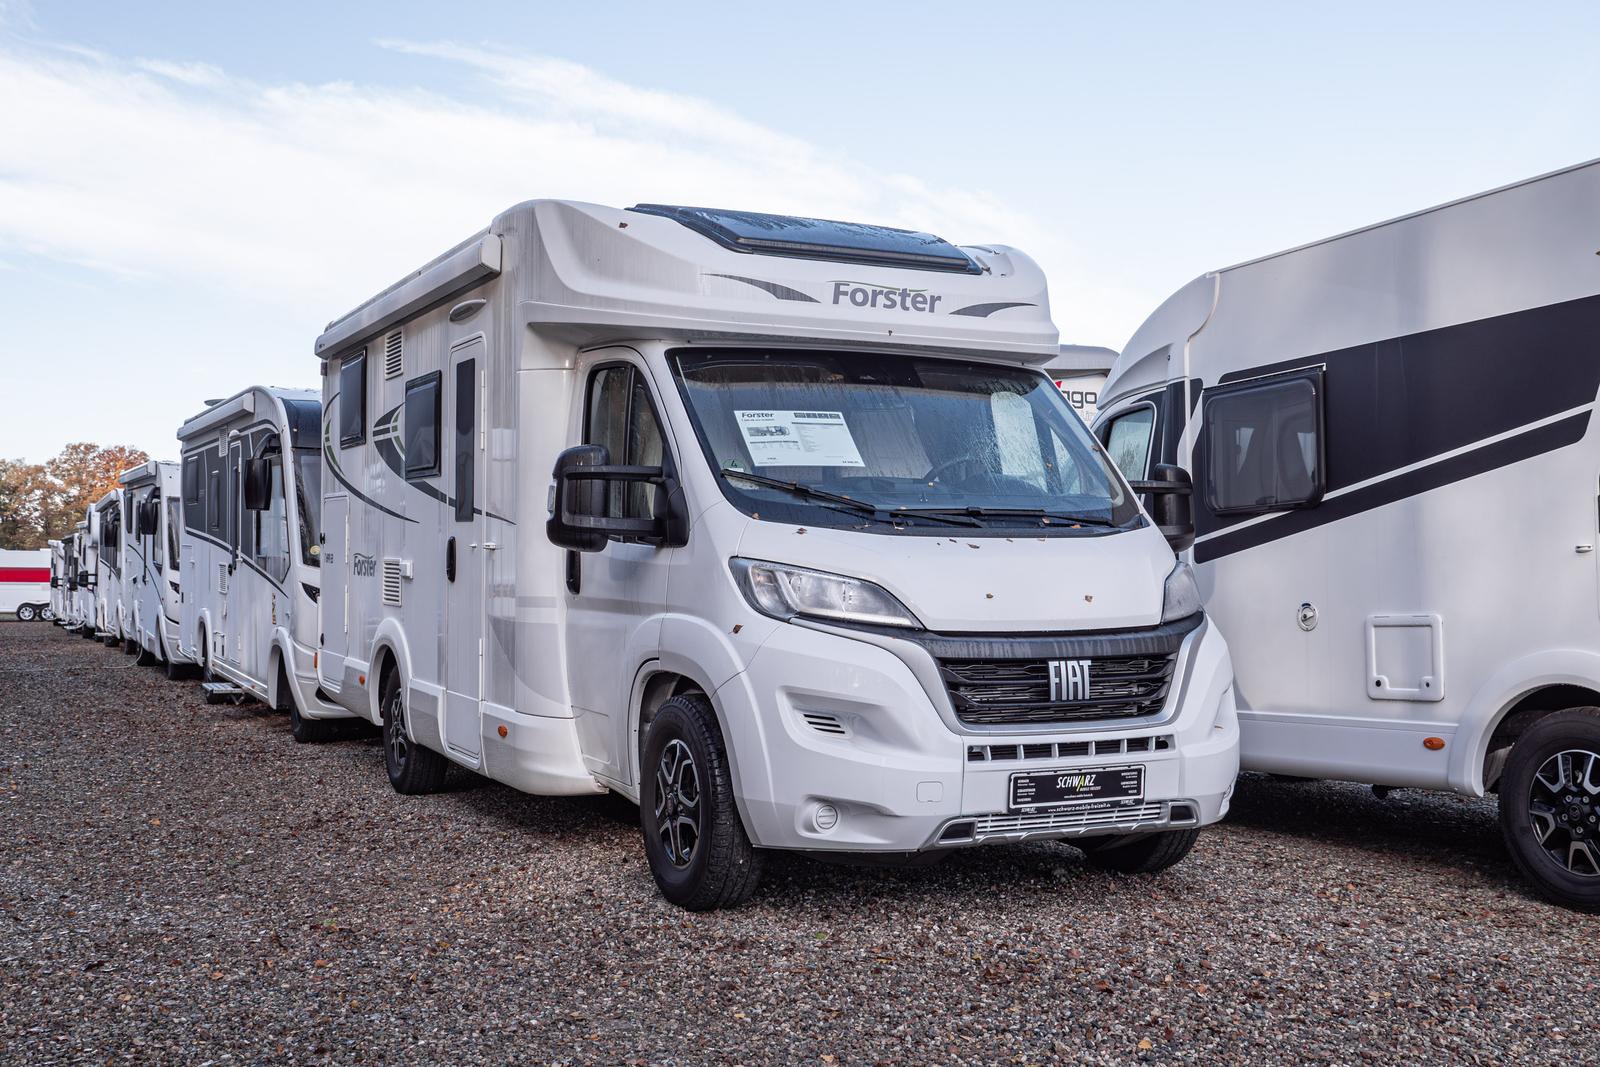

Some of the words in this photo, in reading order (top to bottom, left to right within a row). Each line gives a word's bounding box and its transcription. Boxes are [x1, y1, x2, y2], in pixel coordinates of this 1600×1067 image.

[832, 282, 942, 313] Forster
[731, 459, 738, 468] 4
[353, 555, 377, 577] Forster
[1048, 659, 1092, 701] FIAT
[1056, 774, 1096, 791] SCHWARZ
